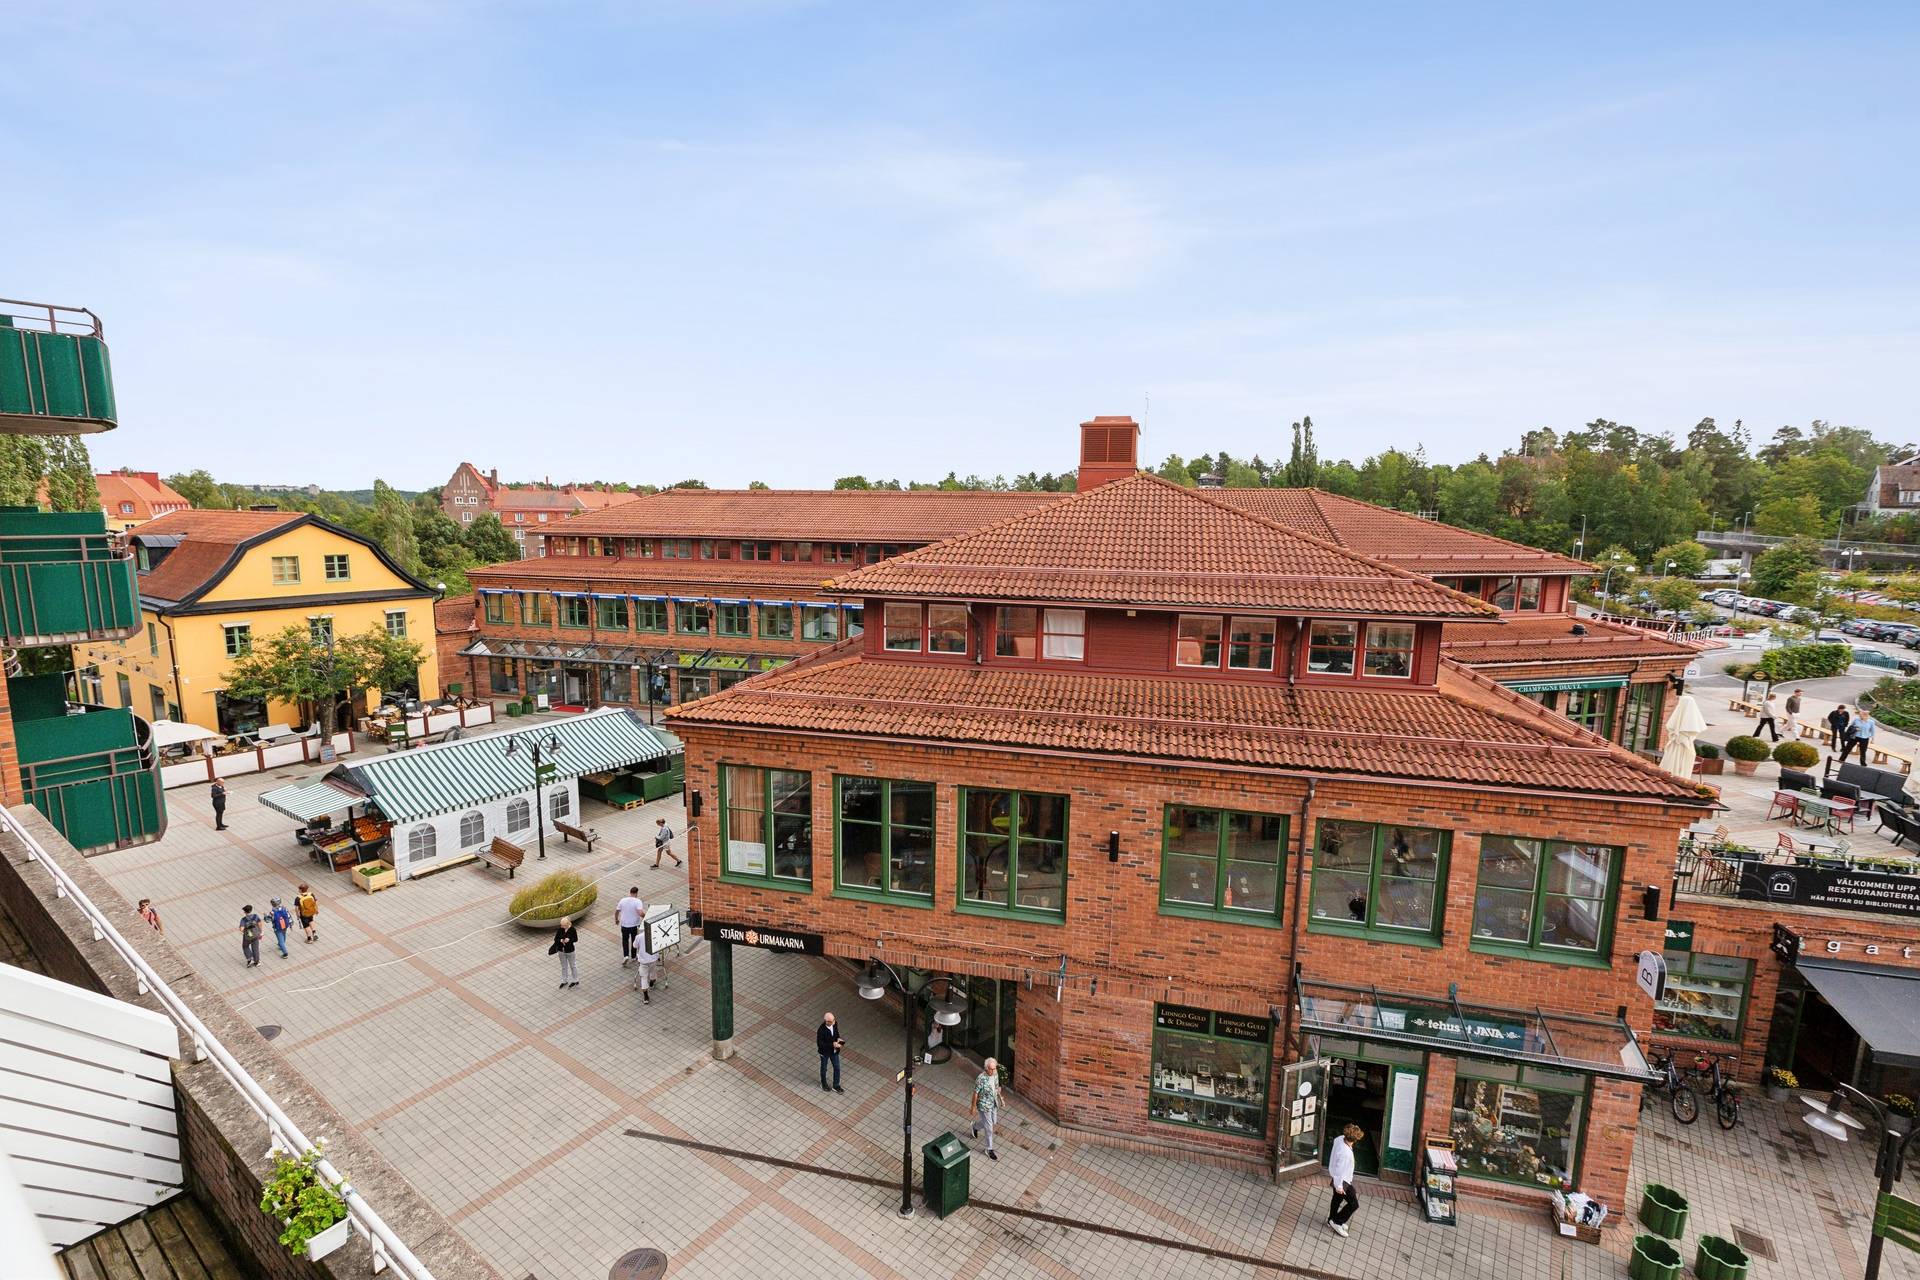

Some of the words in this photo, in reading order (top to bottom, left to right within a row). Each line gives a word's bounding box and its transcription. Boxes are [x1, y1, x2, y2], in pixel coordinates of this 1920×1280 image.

[1836, 878, 1895, 890] VÄLKOMMEN
[1896, 884, 1917, 892] UPP
[1865, 900, 1907, 909] BIBLIOTHEK
[720, 928, 744, 941] STJÄRN
[759, 934, 804, 949] URMAKARNA
[1188, 1012, 1207, 1021] GULD
[1167, 1017, 1174, 1025] &
[1176, 1018, 1199, 1028] DESIGN
[1246, 1021, 1266, 1031] GULD
[1234, 1027, 1258, 1037] DESIGN
[1427, 1018, 1473, 1034] tehust
[1473, 1026, 1505, 1039] JAVA
